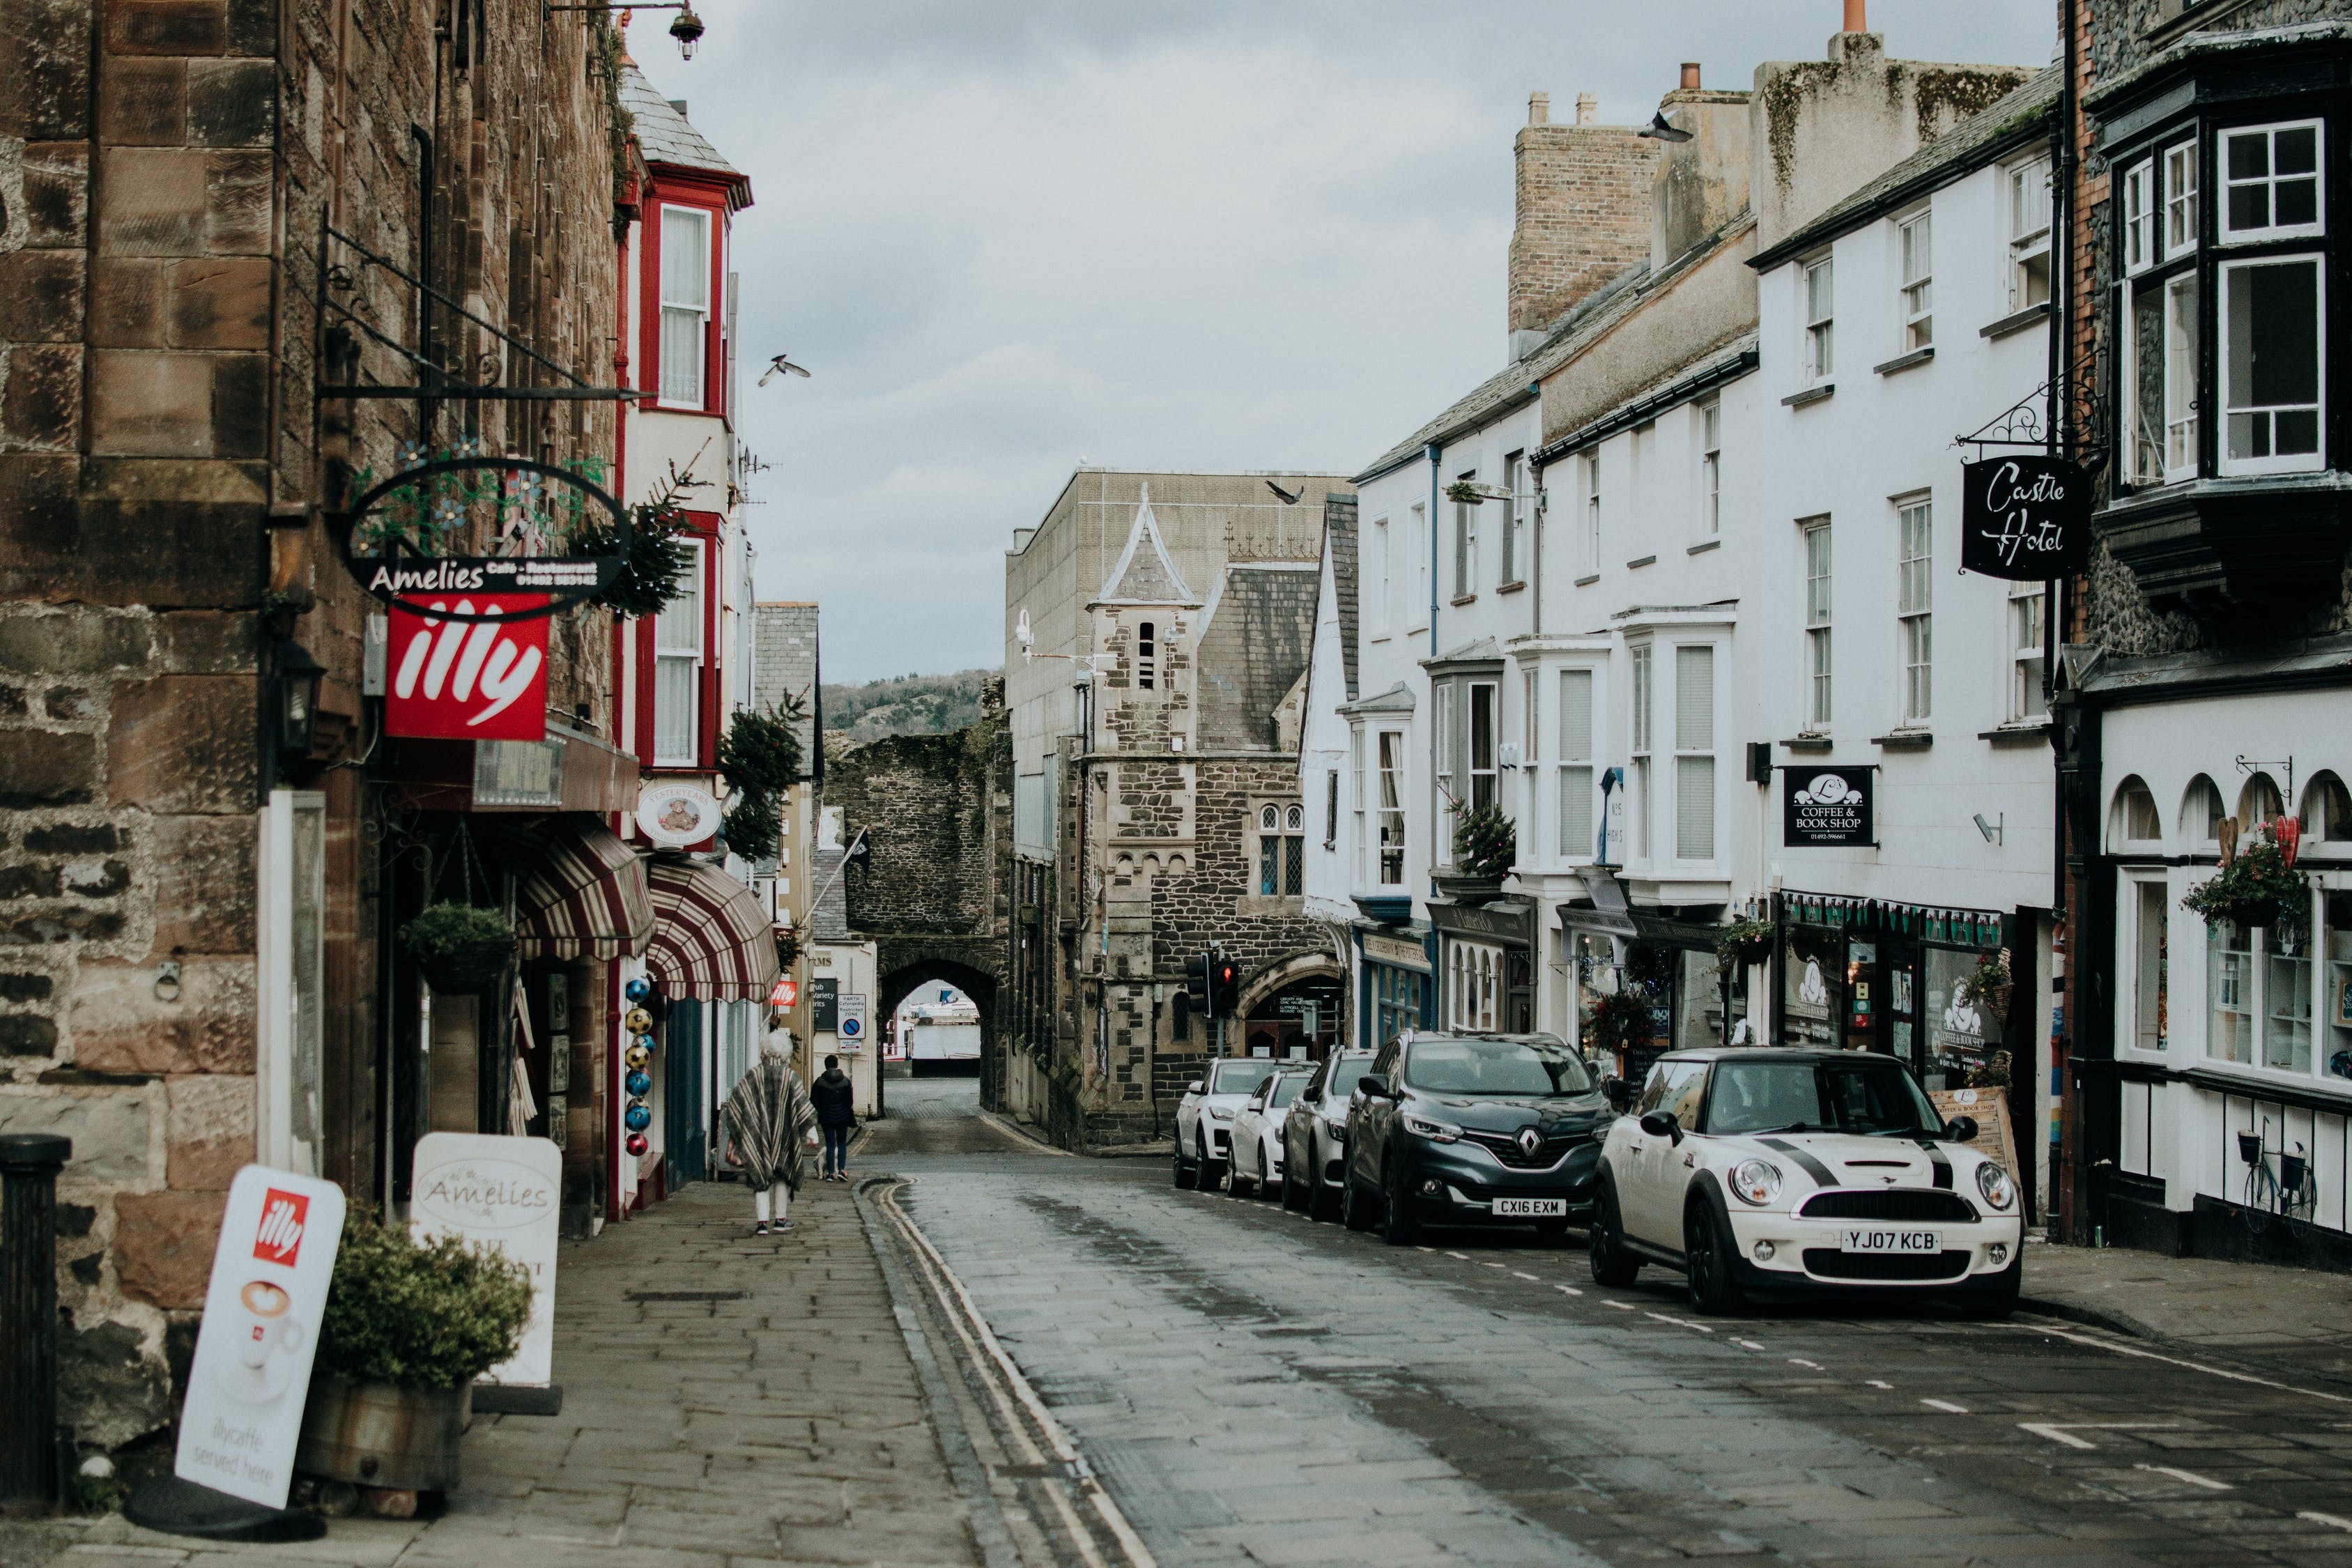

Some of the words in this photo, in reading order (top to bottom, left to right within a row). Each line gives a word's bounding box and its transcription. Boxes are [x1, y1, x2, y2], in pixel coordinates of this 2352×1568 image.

[1988, 462, 2064, 512] Castle
[1981, 508, 2063, 566] Hotel
[369, 560, 484, 591] Amelies
[525, 561, 598, 574] Restaurant
[394, 599, 542, 726] illy
[649, 789, 709, 806] YESTERYEARS
[1801, 808, 1844, 817] COFFEE
[1846, 807, 1855, 817] &
[1796, 818, 1828, 828] BOOK
[1830, 818, 1861, 828] SHOP
[773, 984, 795, 1004] illy
[1940, 1031, 1956, 1043] COFFEE
[1960, 1035, 1973, 1046] BOOK
[1972, 1037, 1985, 1049] SHOP
[424, 1180, 548, 1208] Amelies
[1501, 1201, 1530, 1213] CX16
[1533, 1201, 1558, 1213] EXM
[258, 1199, 303, 1259] illy
[1850, 1231, 1896, 1249] YJ07
[1900, 1233, 1934, 1249] KCB
[193, 1446, 240, 1475] served
[243, 1454, 275, 1486] here
